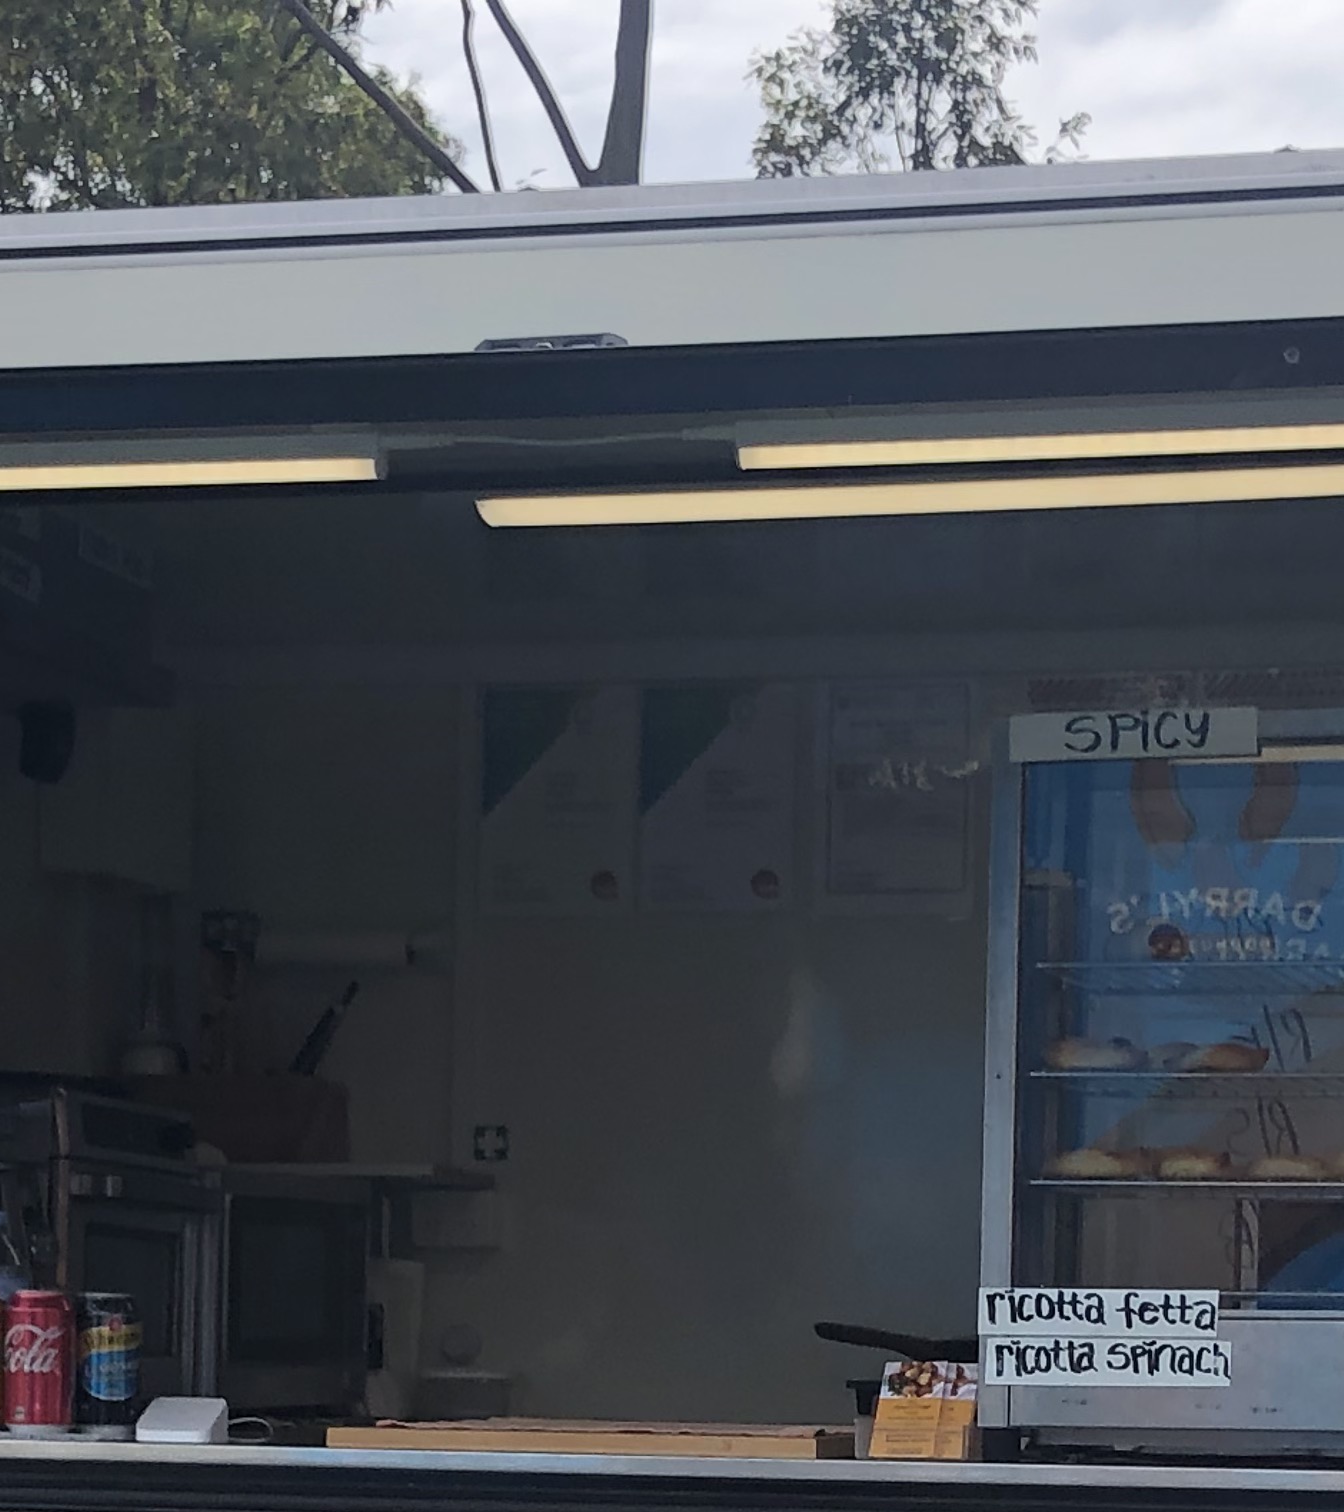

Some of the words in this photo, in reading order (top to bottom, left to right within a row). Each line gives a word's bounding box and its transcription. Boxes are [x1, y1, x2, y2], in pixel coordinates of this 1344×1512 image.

[986, 1289, 1106, 1325] ricotta
[1116, 1291, 1217, 1331] fetta
[994, 1341, 1097, 1378] ricotta
[1106, 1341, 1231, 1381] spinach
